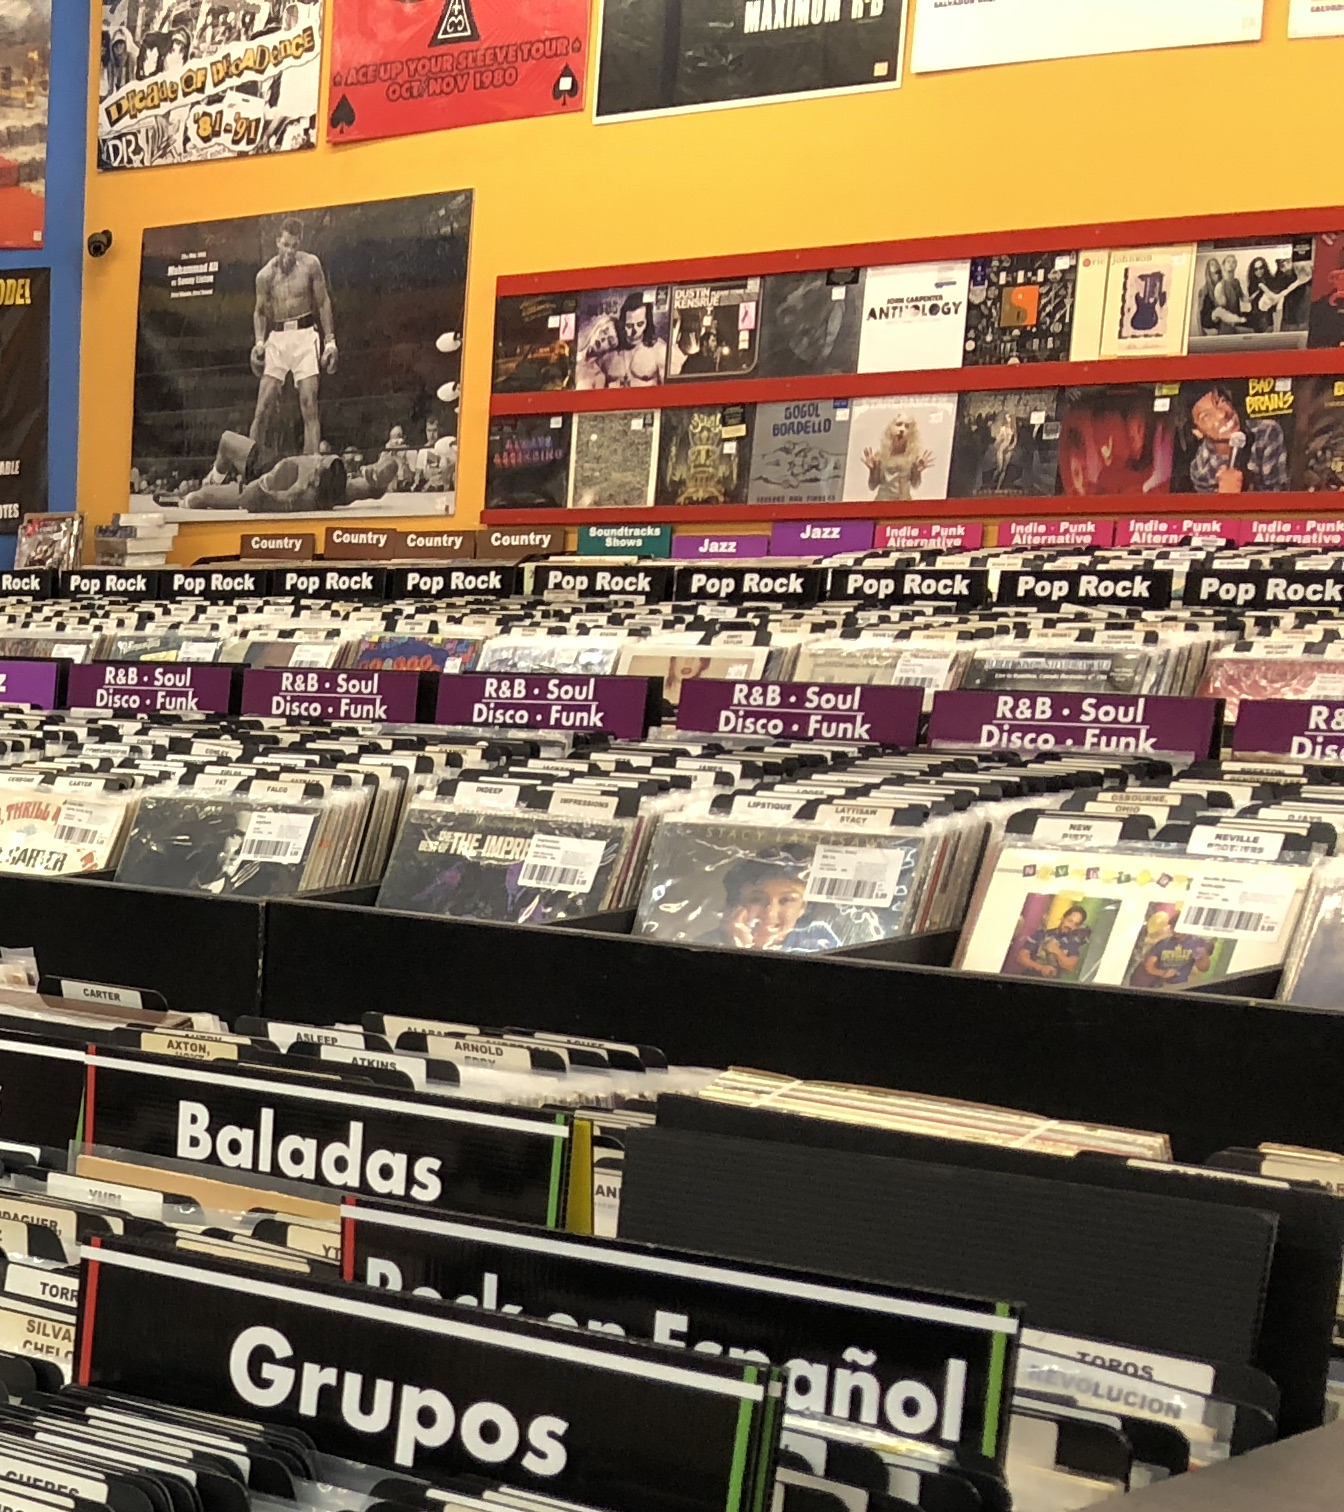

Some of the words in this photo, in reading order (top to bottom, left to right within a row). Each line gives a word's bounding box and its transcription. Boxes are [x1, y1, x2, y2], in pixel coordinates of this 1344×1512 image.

[744, 0, 841, 34] MAXIMUM
[344, 66, 378, 87] ACE
[381, 65, 403, 82] UP
[406, 57, 454, 79] YOUR
[457, 48, 519, 72] SLEEVE
[521, 38, 570, 61] TOUR
[474, 68, 517, 90] 1980
[674, 288, 710, 299] DUSTIN
[1249, 378, 1274, 396] BAD
[1246, 392, 1294, 415] BRAINS
[1059, 521, 1096, 533] Punk
[332, 530, 387, 548] Country
[173, 574, 207, 595] Pop
[212, 573, 255, 591] Rock
[847, 576, 895, 598] Pop
[902, 575, 970, 595] Rock
[104, 666, 139, 686] R&B
[154, 666, 192, 688] Soul
[95, 688, 140, 709] Disco
[156, 690, 200, 712] Funk
[840, 816, 867, 824] STACY
[1215, 833, 1260, 844] NEVILLE
[83, 988, 121, 1001] CARTER
[454, 1040, 504, 1056] ARNOLD
[177, 1100, 443, 1202] Baladas
[229, 1325, 569, 1478] Grupos
